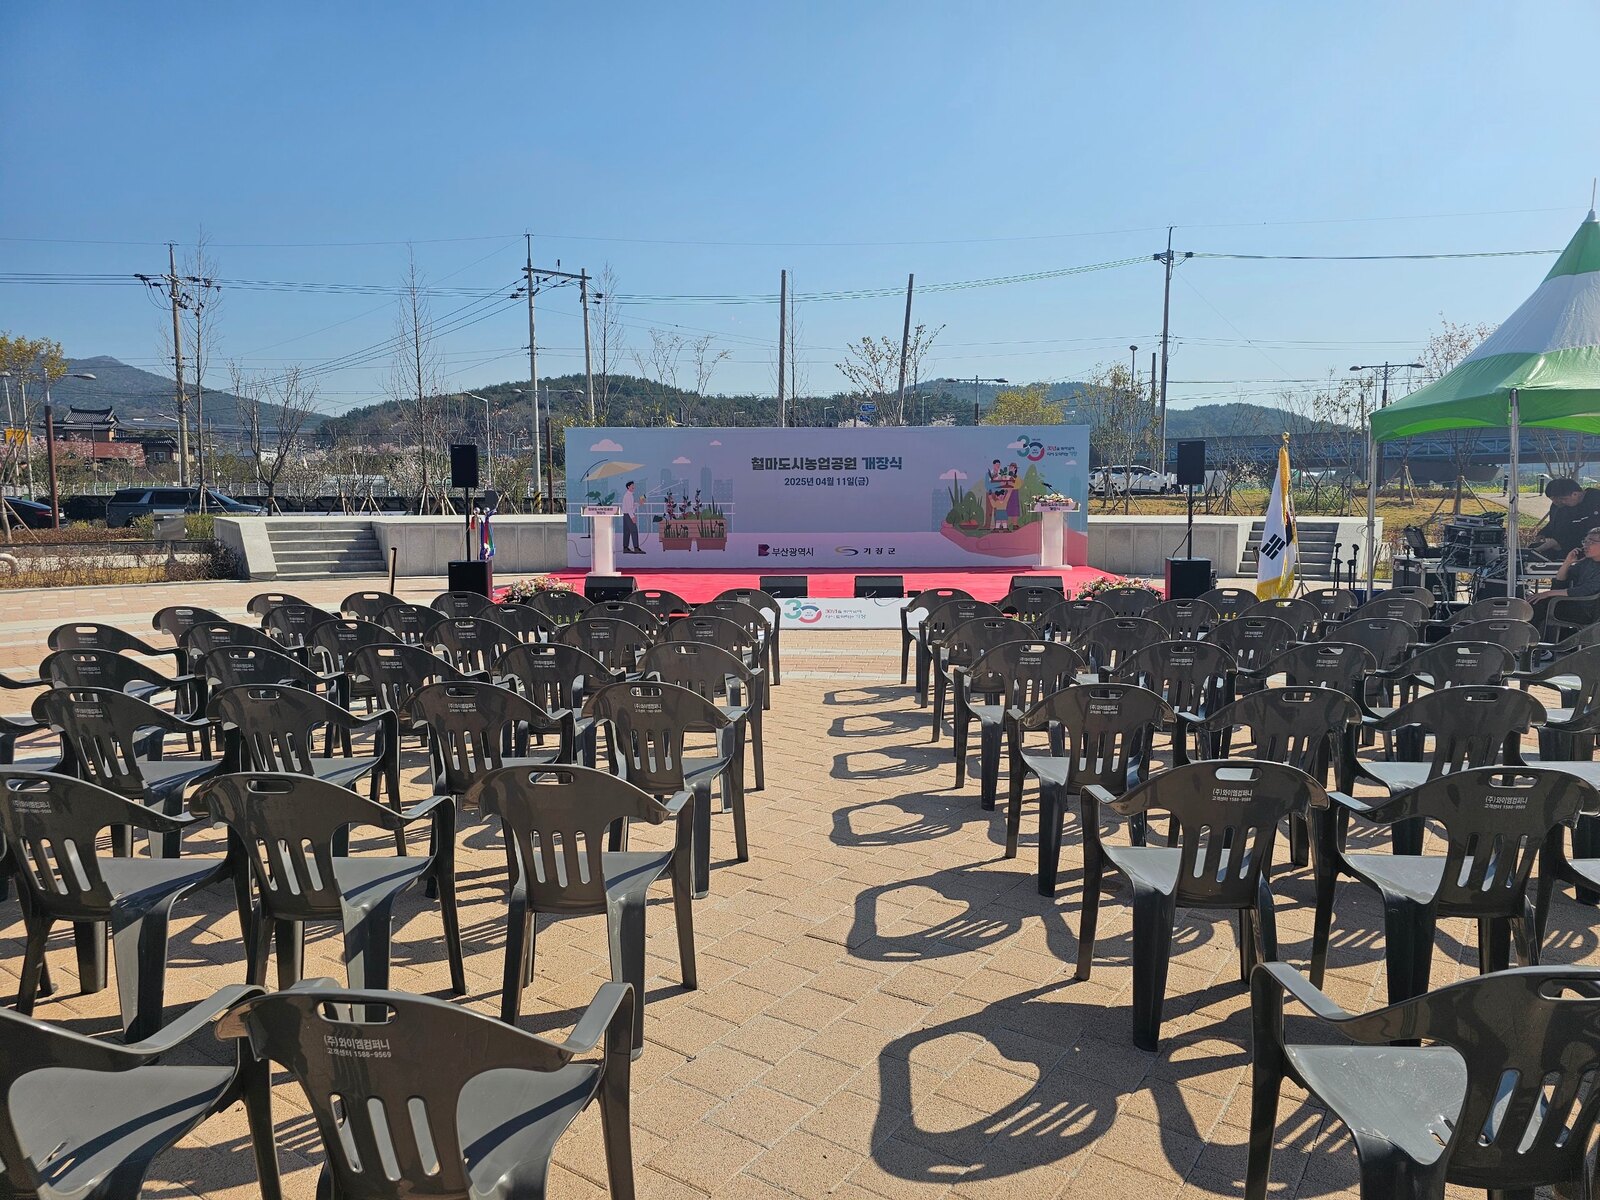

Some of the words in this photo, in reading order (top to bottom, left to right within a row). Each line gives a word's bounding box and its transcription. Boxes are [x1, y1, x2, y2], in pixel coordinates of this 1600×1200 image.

[751, 456, 857, 471] 철마도시농업공원
[861, 456, 903, 470] 개장식
[784, 477, 814, 487] 2025년
[815, 477, 834, 487] 04월
[836, 476, 869, 487] 11일(금)
[771, 547, 814, 557] 부산광역시
[323, 1034, 390, 1050] (주)와이엠컴퍼니
